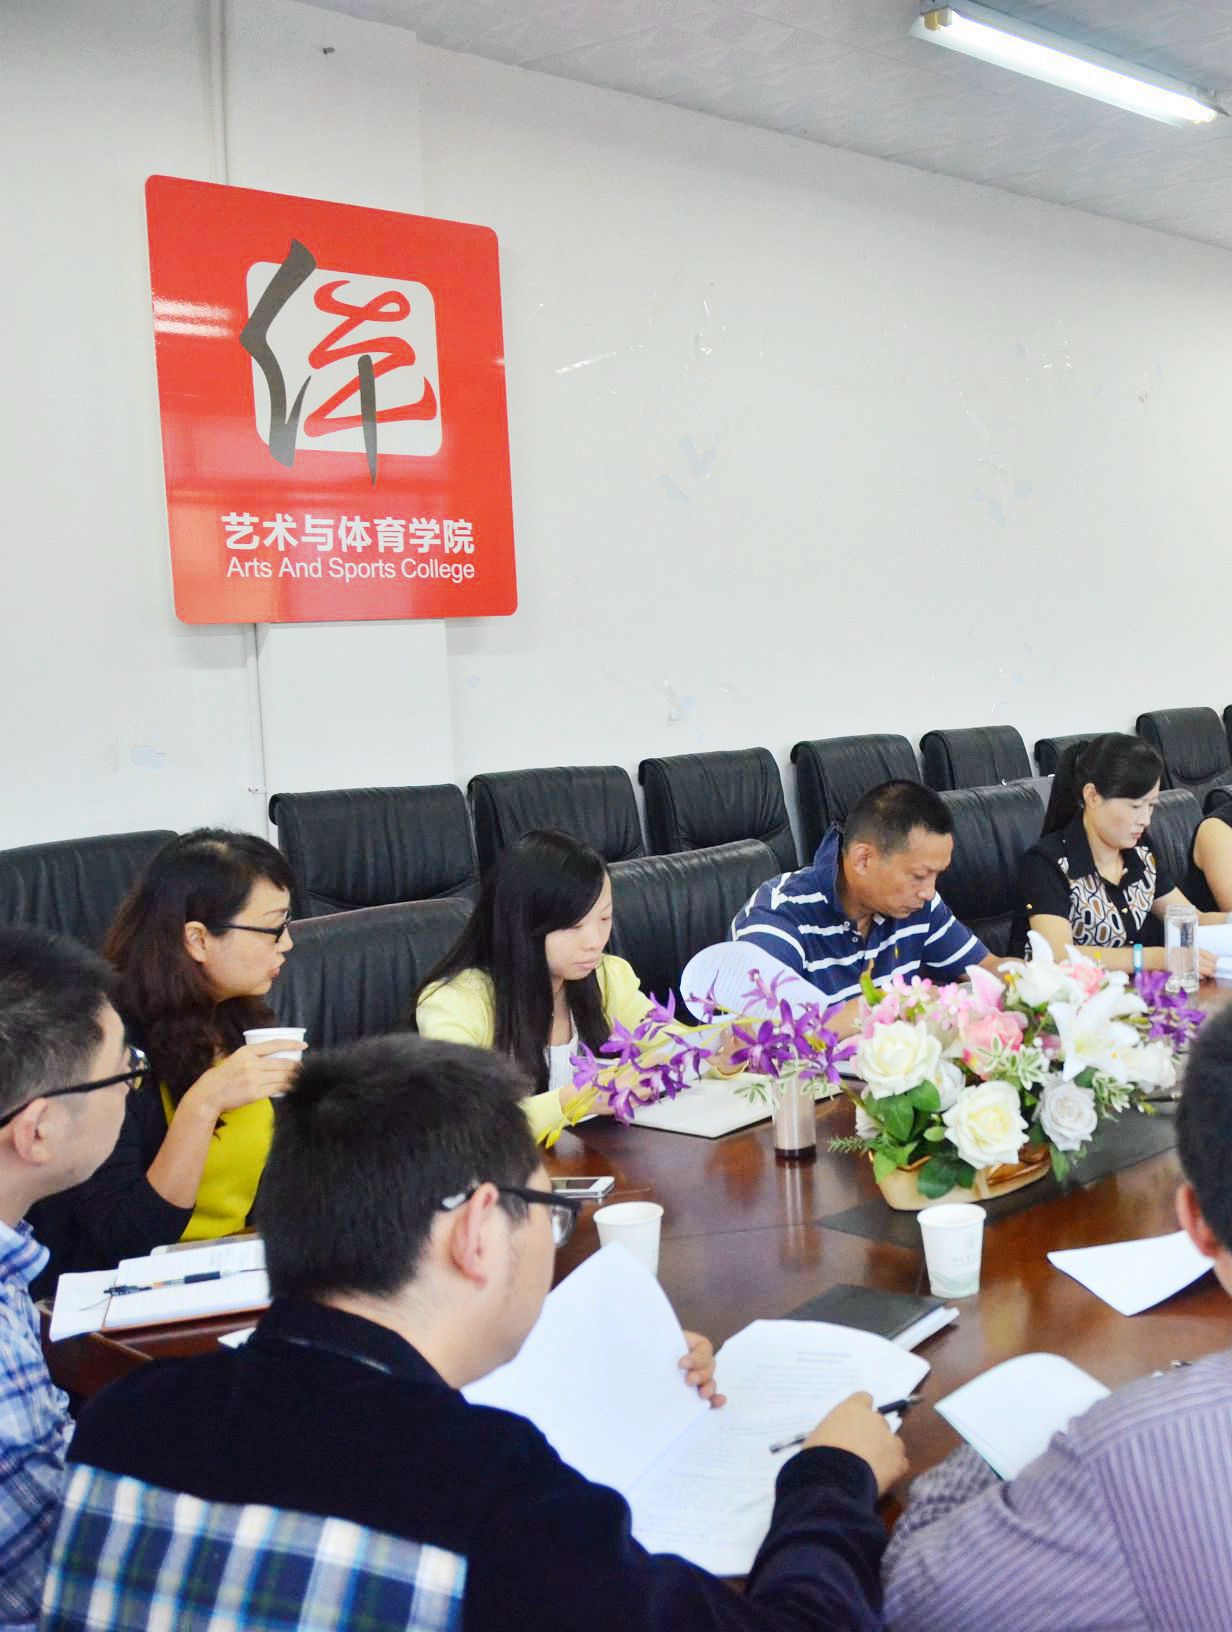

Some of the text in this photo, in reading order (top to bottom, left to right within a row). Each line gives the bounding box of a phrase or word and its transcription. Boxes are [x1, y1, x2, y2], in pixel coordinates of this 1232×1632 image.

[221, 512, 475, 554] 艺术与体育学院
[226, 556, 475, 584] Arts And Sports College
